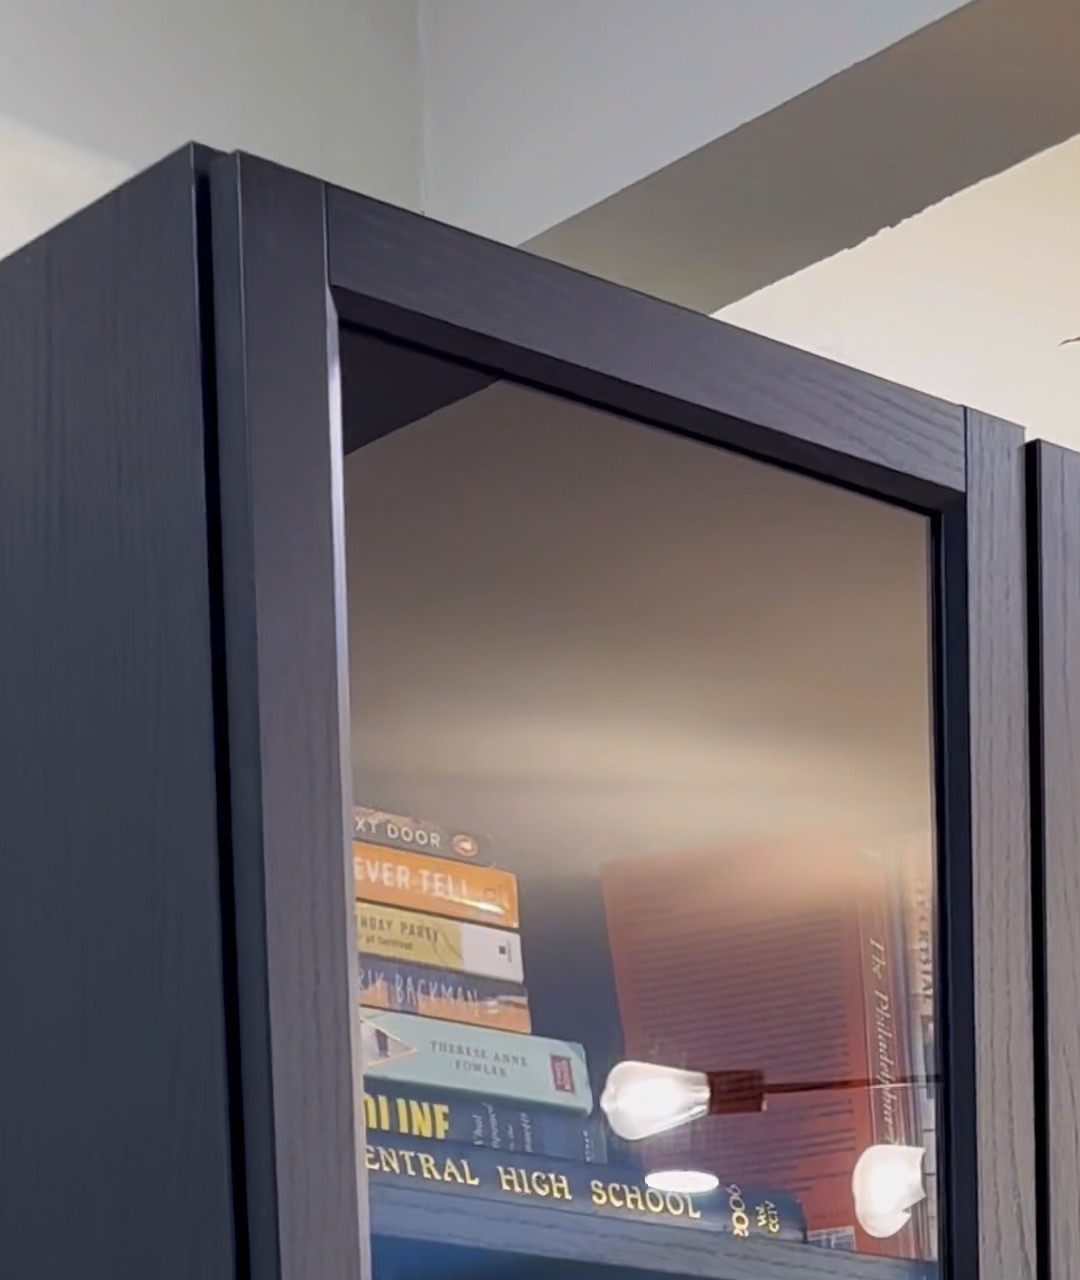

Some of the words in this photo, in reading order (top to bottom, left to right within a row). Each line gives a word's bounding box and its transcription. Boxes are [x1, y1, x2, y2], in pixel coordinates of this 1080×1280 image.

[387, 824, 441, 848] DOOR
[869, 937, 888, 980] The
[395, 974, 481, 1018] BACKMAN
[365, 1145, 480, 1186] ENTRAL
[496, 1165, 573, 1200] HIGH
[590, 1179, 702, 1219] SCHOOL
